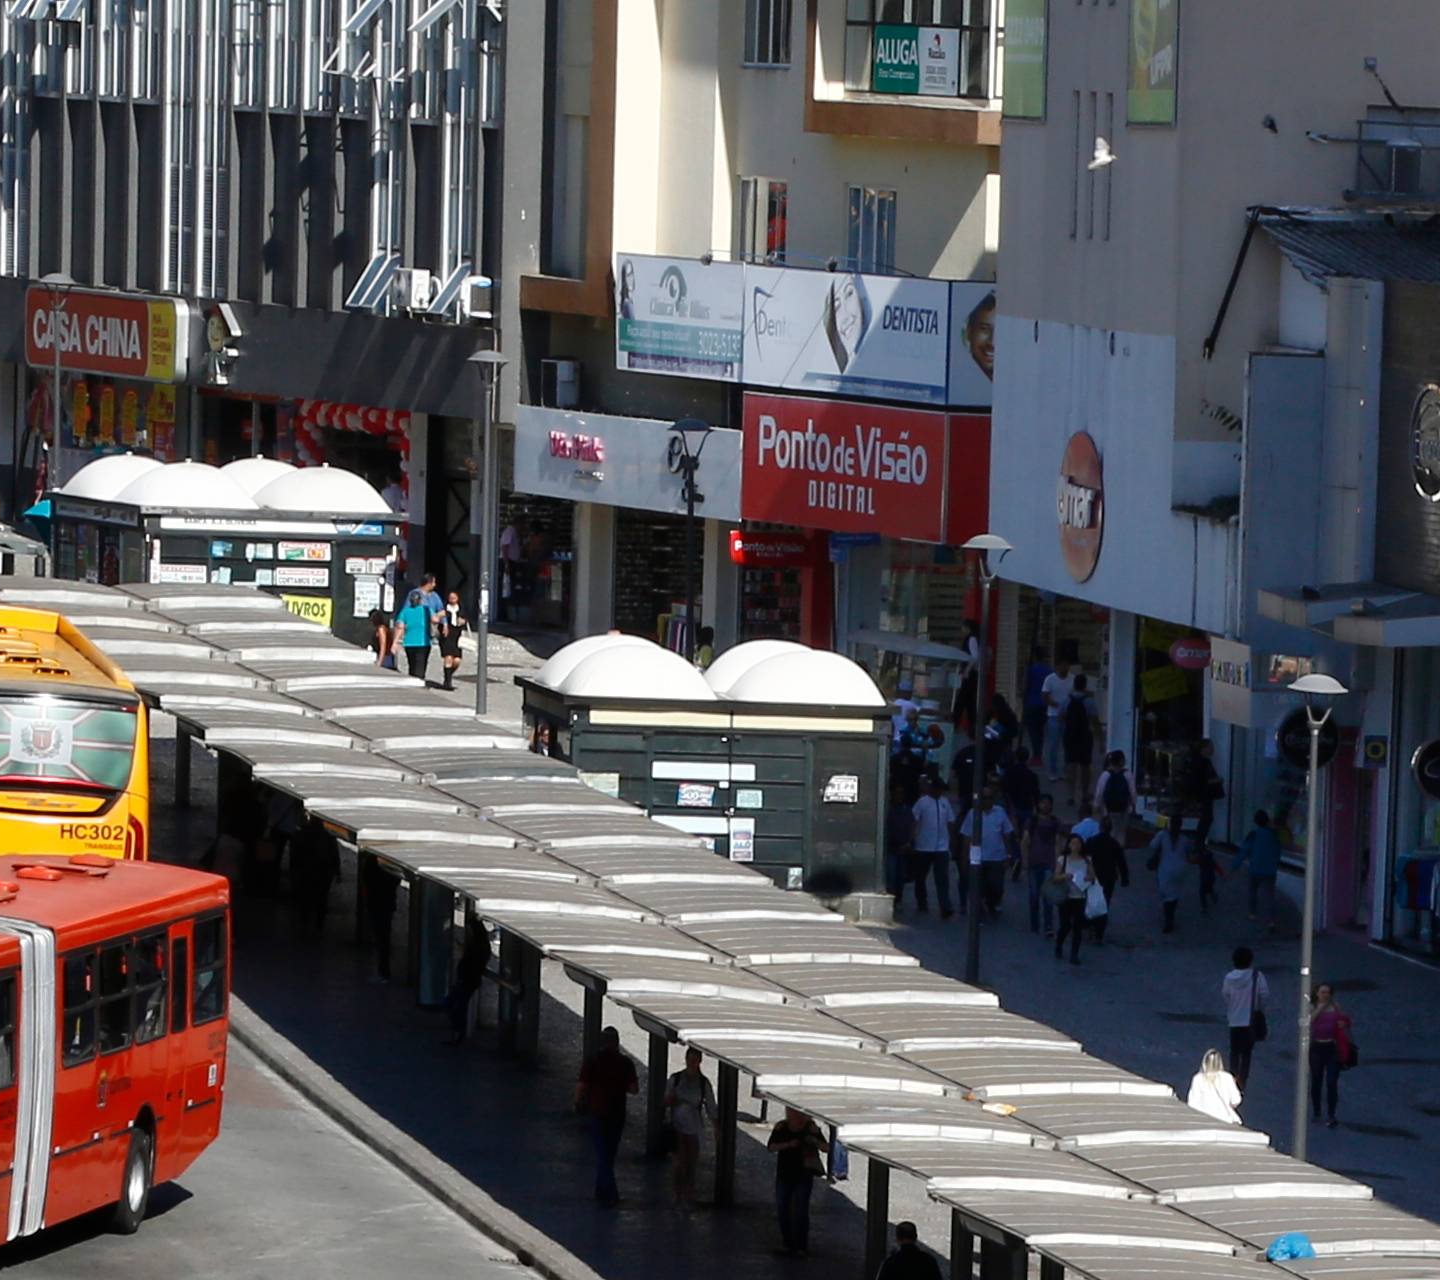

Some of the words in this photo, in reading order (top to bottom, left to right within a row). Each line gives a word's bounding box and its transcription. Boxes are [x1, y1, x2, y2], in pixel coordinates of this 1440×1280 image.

[876, 38, 919, 66] ALUGA
[33, 308, 82, 353] CASA
[85, 314, 141, 361] CHINA
[882, 304, 939, 336] DENTISTA
[758, 414, 831, 474] Ponto
[832, 435, 855, 477] de
[855, 423, 929, 487] Visão
[807, 479, 876, 516] DIGITAL
[60, 824, 125, 841] HC302
